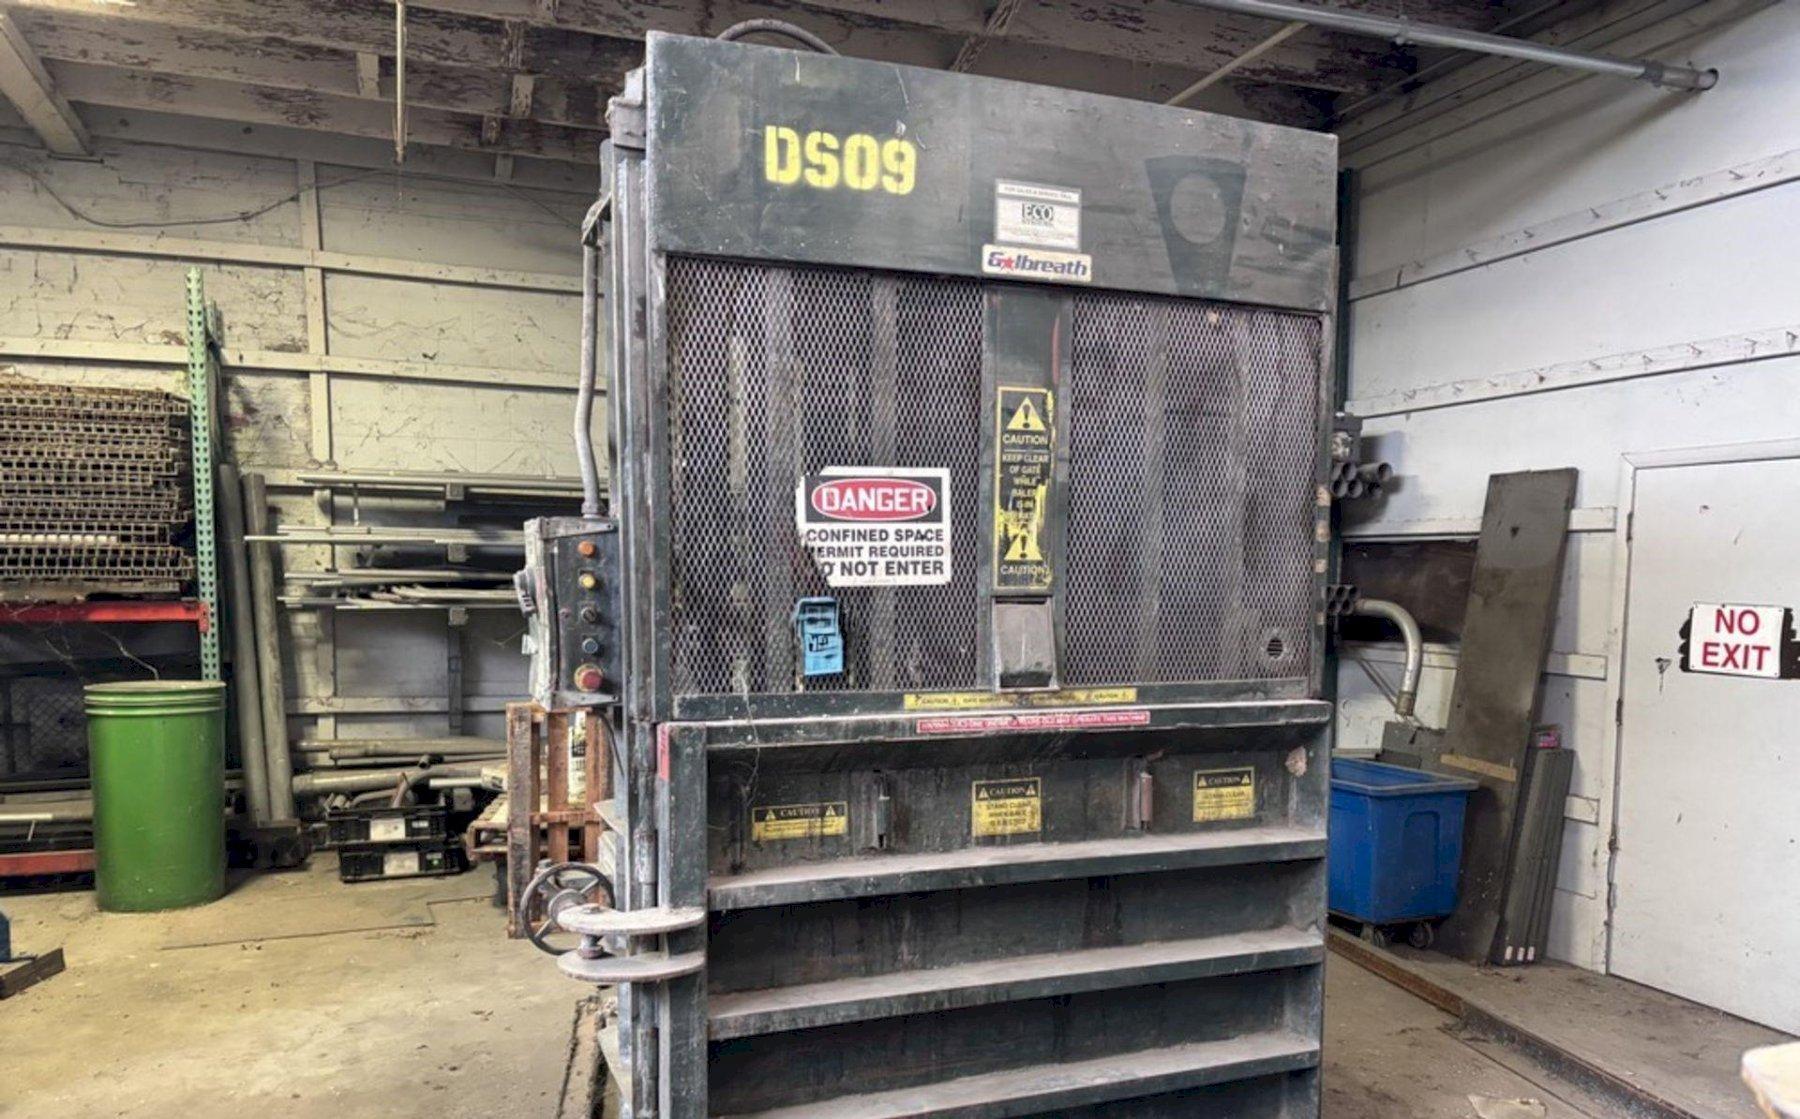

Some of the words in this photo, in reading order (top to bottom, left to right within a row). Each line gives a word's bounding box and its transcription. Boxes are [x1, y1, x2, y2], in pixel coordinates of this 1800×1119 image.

[765, 125, 917, 195] DS09
[1002, 433, 1048, 445] CAUTION
[1002, 454, 1022, 462] KEEP
[1024, 454, 1049, 463] CLEAR
[1009, 465, 1019, 474] OF
[1021, 465, 1041, 474] GATE
[821, 487, 929, 512] DANGER
[807, 528, 889, 542] CONFINED
[894, 528, 944, 542] SPACE
[812, 546, 864, 558] ERMIT
[869, 546, 944, 558] REQUIRED
[820, 561, 836, 577] O
[841, 561, 878, 576] NOT
[885, 560, 944, 575] ENTER
[1000, 564, 1048, 576] CAUTION
[1715, 609, 1760, 635] NO
[1702, 642, 1771, 671] EXIT
